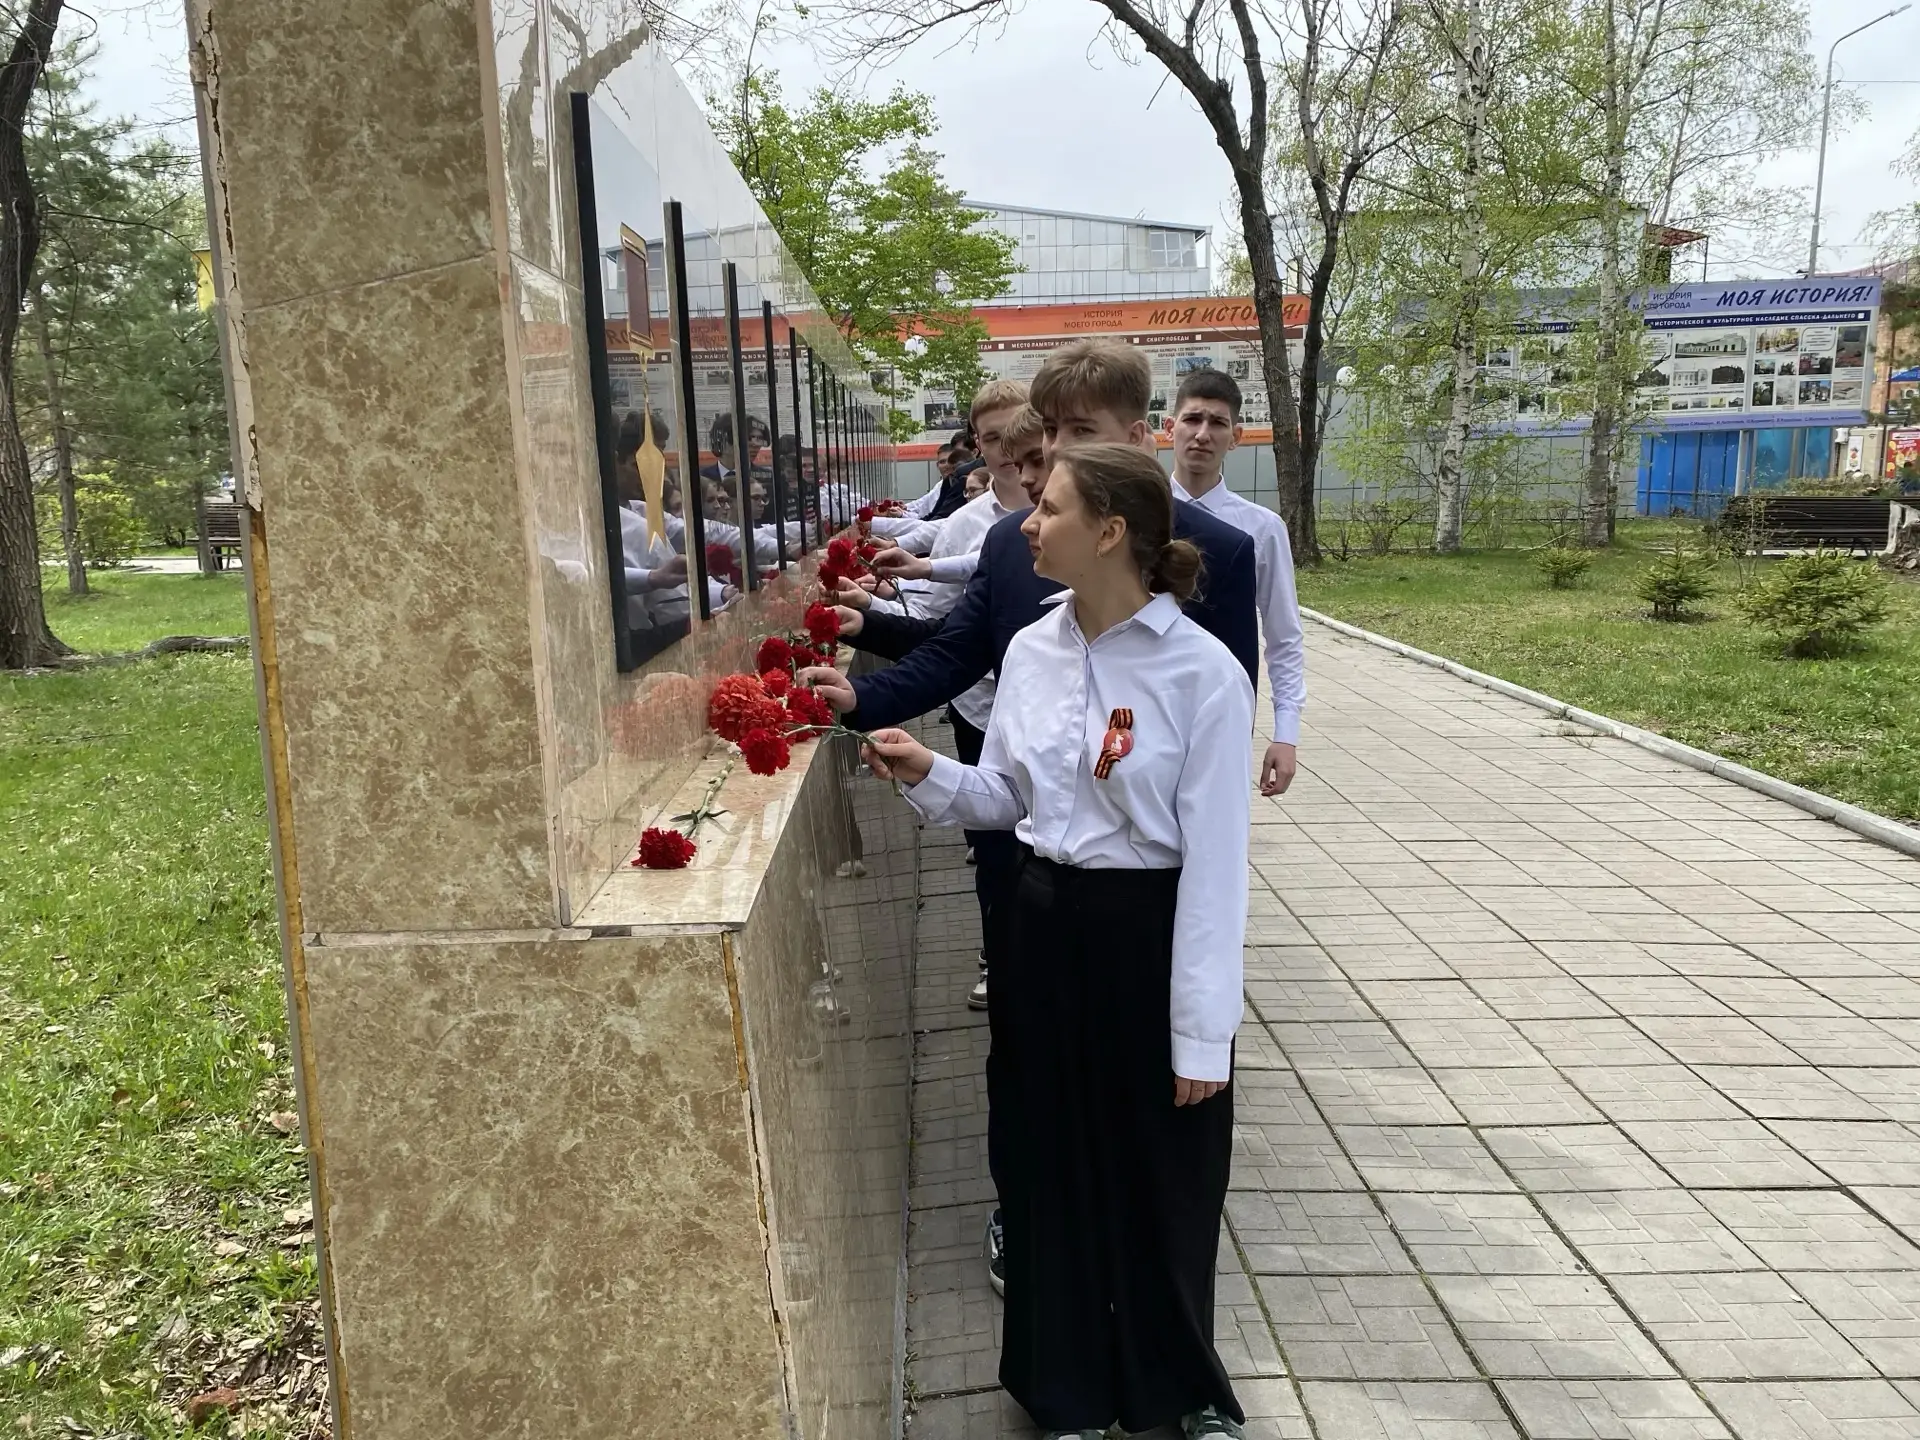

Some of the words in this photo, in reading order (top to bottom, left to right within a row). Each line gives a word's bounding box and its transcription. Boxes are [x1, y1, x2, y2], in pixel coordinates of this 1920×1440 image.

[1716, 289, 1766, 307] МОЯ
[1769, 285, 1874, 305] ИСТОРИЯ!
[1083, 309, 1123, 318] ИСТОРИЯ
[1148, 307, 1197, 325] МОЯ
[1201, 303, 1303, 323] ИСТОЯ!
[1654, 318, 1705, 327] ИСТОРИЧЕСКОЕ
[1713, 316, 1753, 324] КУЛЬТУРНОЕ
[1755, 314, 1789, 322] НАСЛЕДИЕ
[1790, 312, 1856, 321] СПАССКА-ДАЛЬНЕГО
[1064, 321, 1090, 329] МОЕГО
[1091, 320, 1123, 328] ГОРОДА
[1146, 335, 1165, 343] СКВЕР
